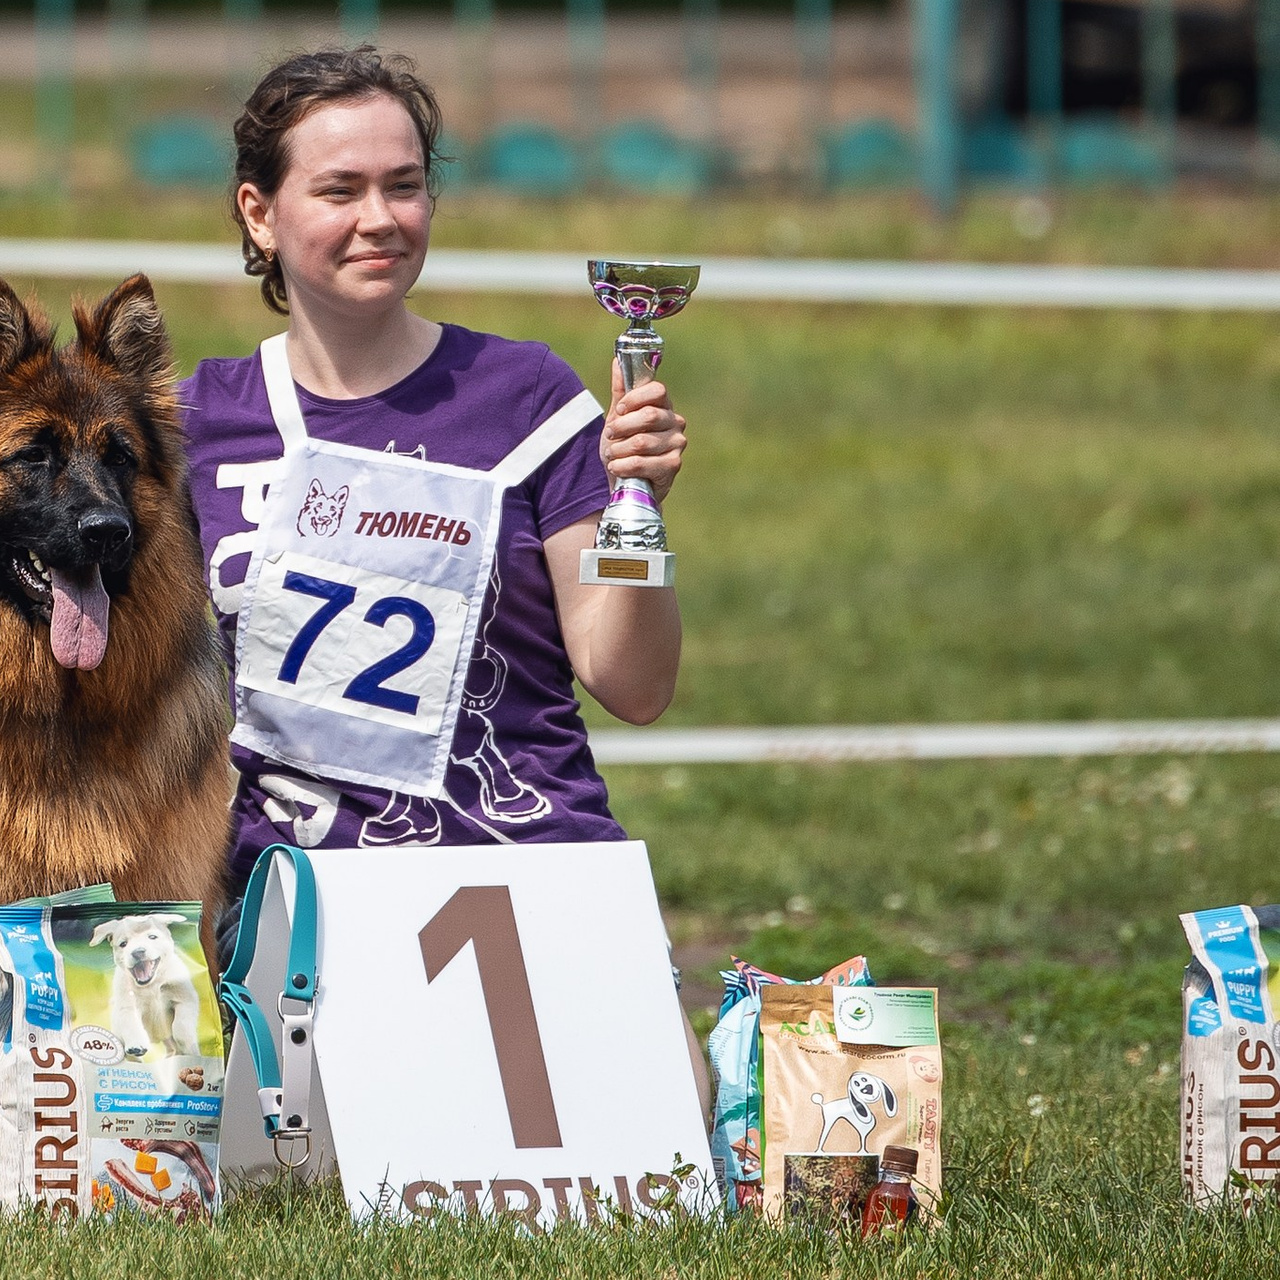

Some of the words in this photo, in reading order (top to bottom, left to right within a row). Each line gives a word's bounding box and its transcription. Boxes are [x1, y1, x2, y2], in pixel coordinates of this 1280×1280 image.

[355, 511, 472, 546] ТЮМЕНЬ
[277, 570, 436, 716] 72
[31, 983, 58, 1001] PUPPY
[1227, 981, 1256, 998] PUPPY
[417, 885, 563, 1149] 1
[83, 1039, 114, 1051] 48%
[97, 1068, 154, 1081] ЯГНЕНОК
[207, 1083, 212, 1092] 2
[923, 1098, 938, 1153] TASTY
[403, 1174, 687, 1234] SIRIUS
